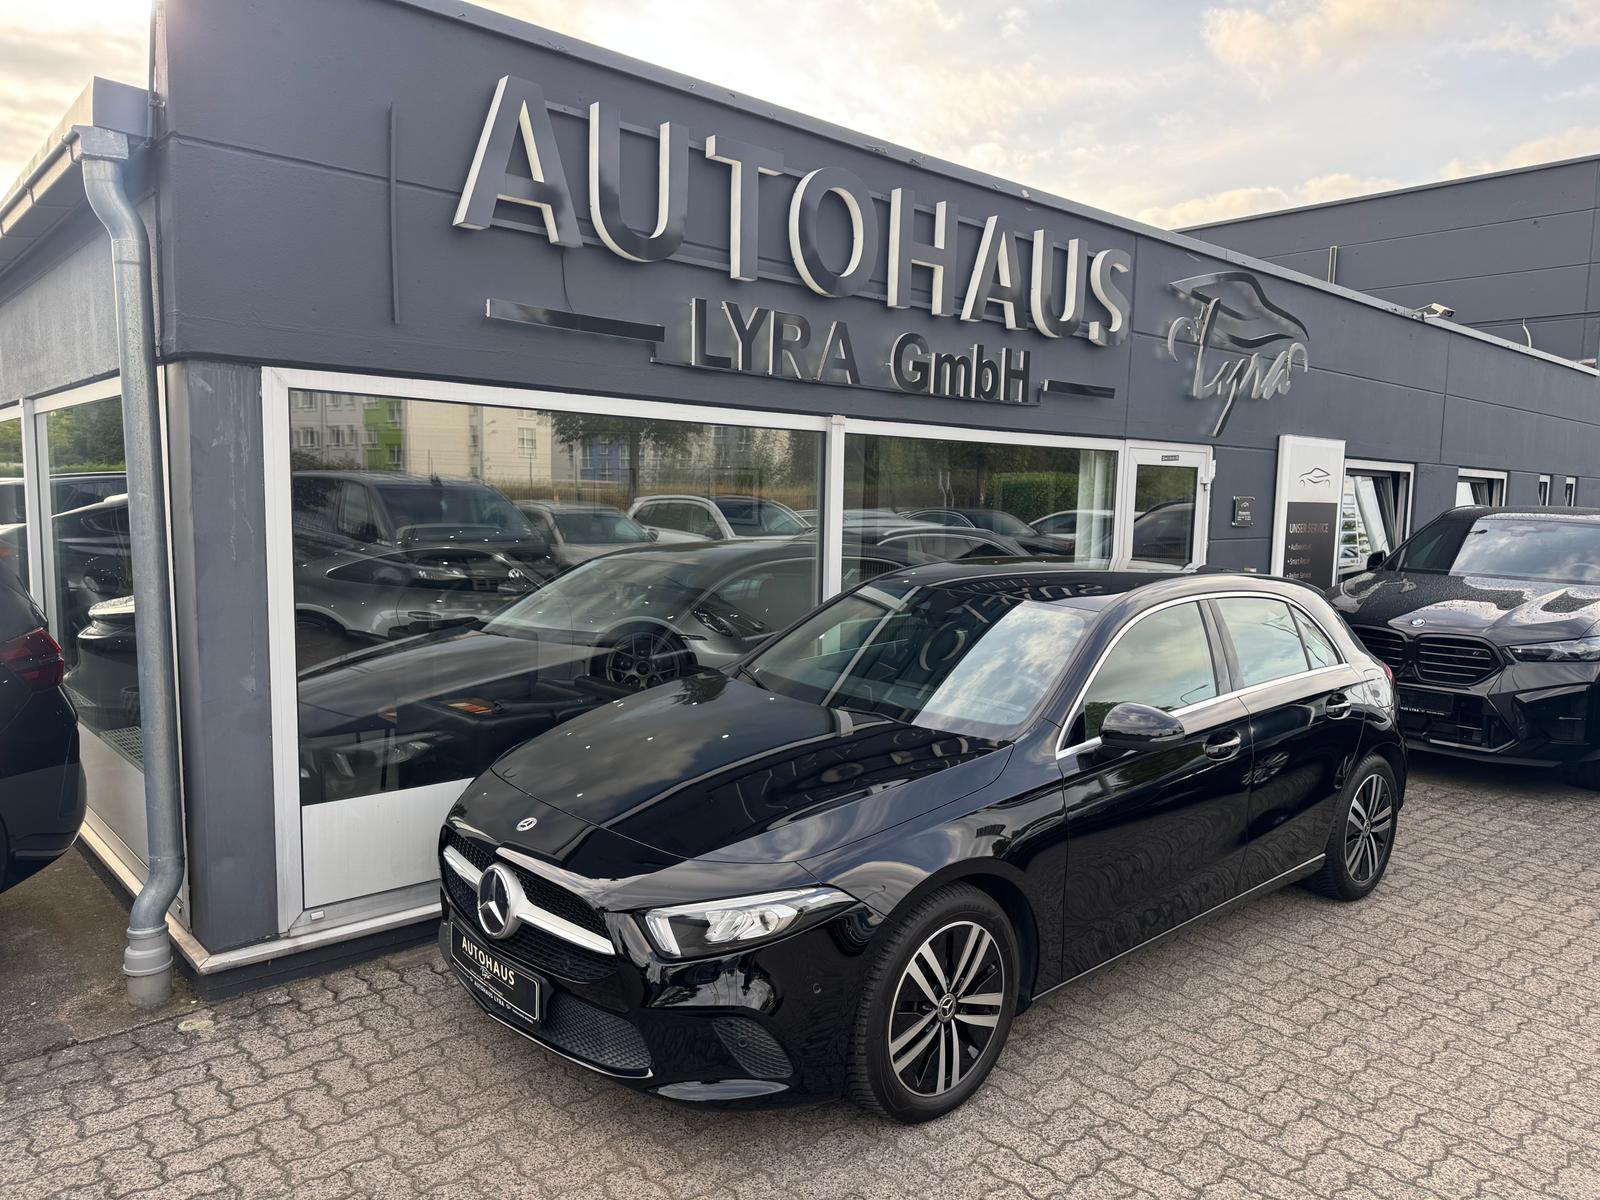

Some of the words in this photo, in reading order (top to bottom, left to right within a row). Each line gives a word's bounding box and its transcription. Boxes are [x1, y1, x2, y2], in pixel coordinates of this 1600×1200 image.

[452, 74, 1132, 347] AUTOHAUS
[691, 297, 861, 386] LYRA
[890, 331, 1031, 403] GmbH
[462, 936, 515, 986] AUTOHAUS
